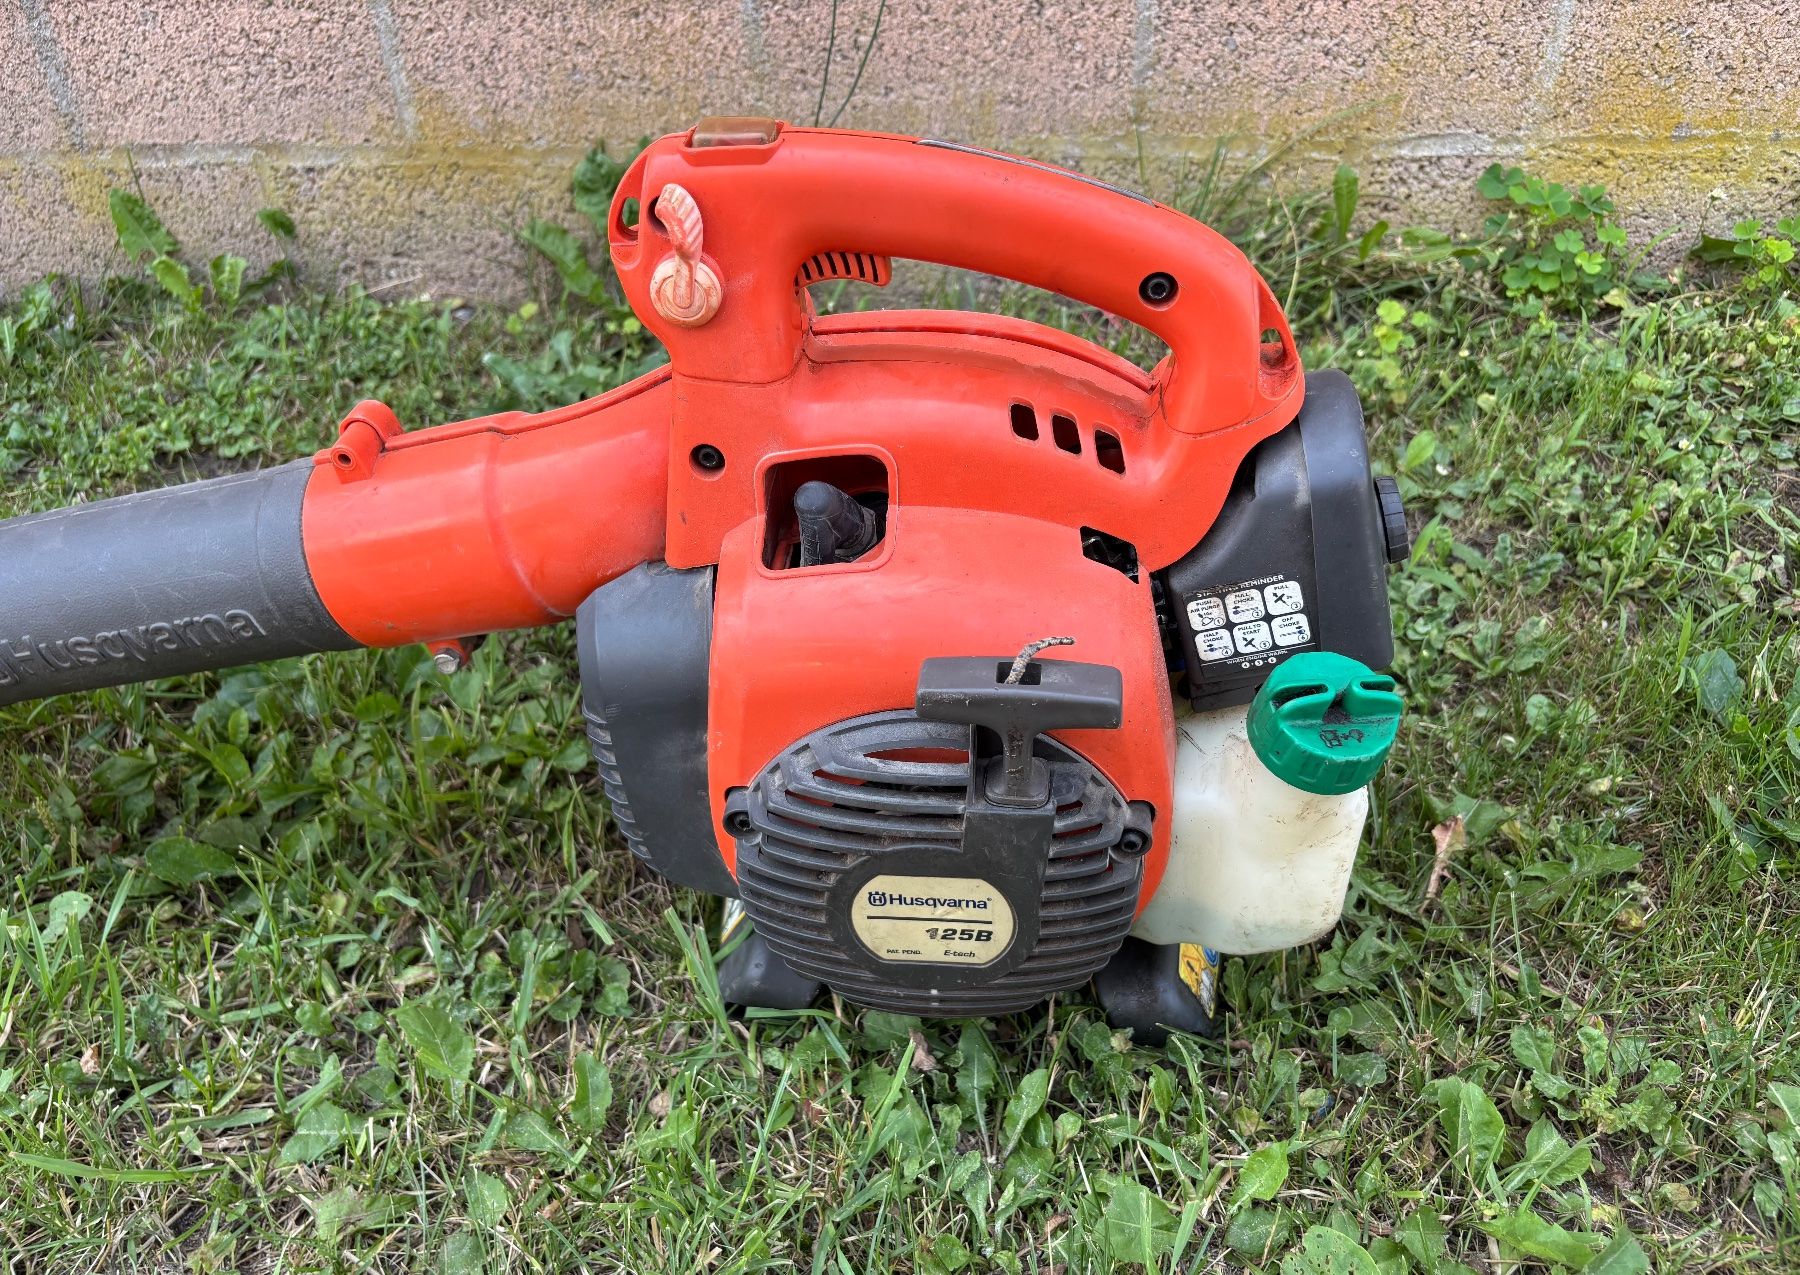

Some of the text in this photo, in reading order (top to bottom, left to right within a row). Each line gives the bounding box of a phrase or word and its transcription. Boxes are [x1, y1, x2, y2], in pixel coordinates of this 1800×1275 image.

[1240, 574, 1284, 588] REMINDER
[1, 609, 267, 682] Husqvarna
[889, 894, 987, 909] Husqvarna
[926, 928, 993, 942] 125B
